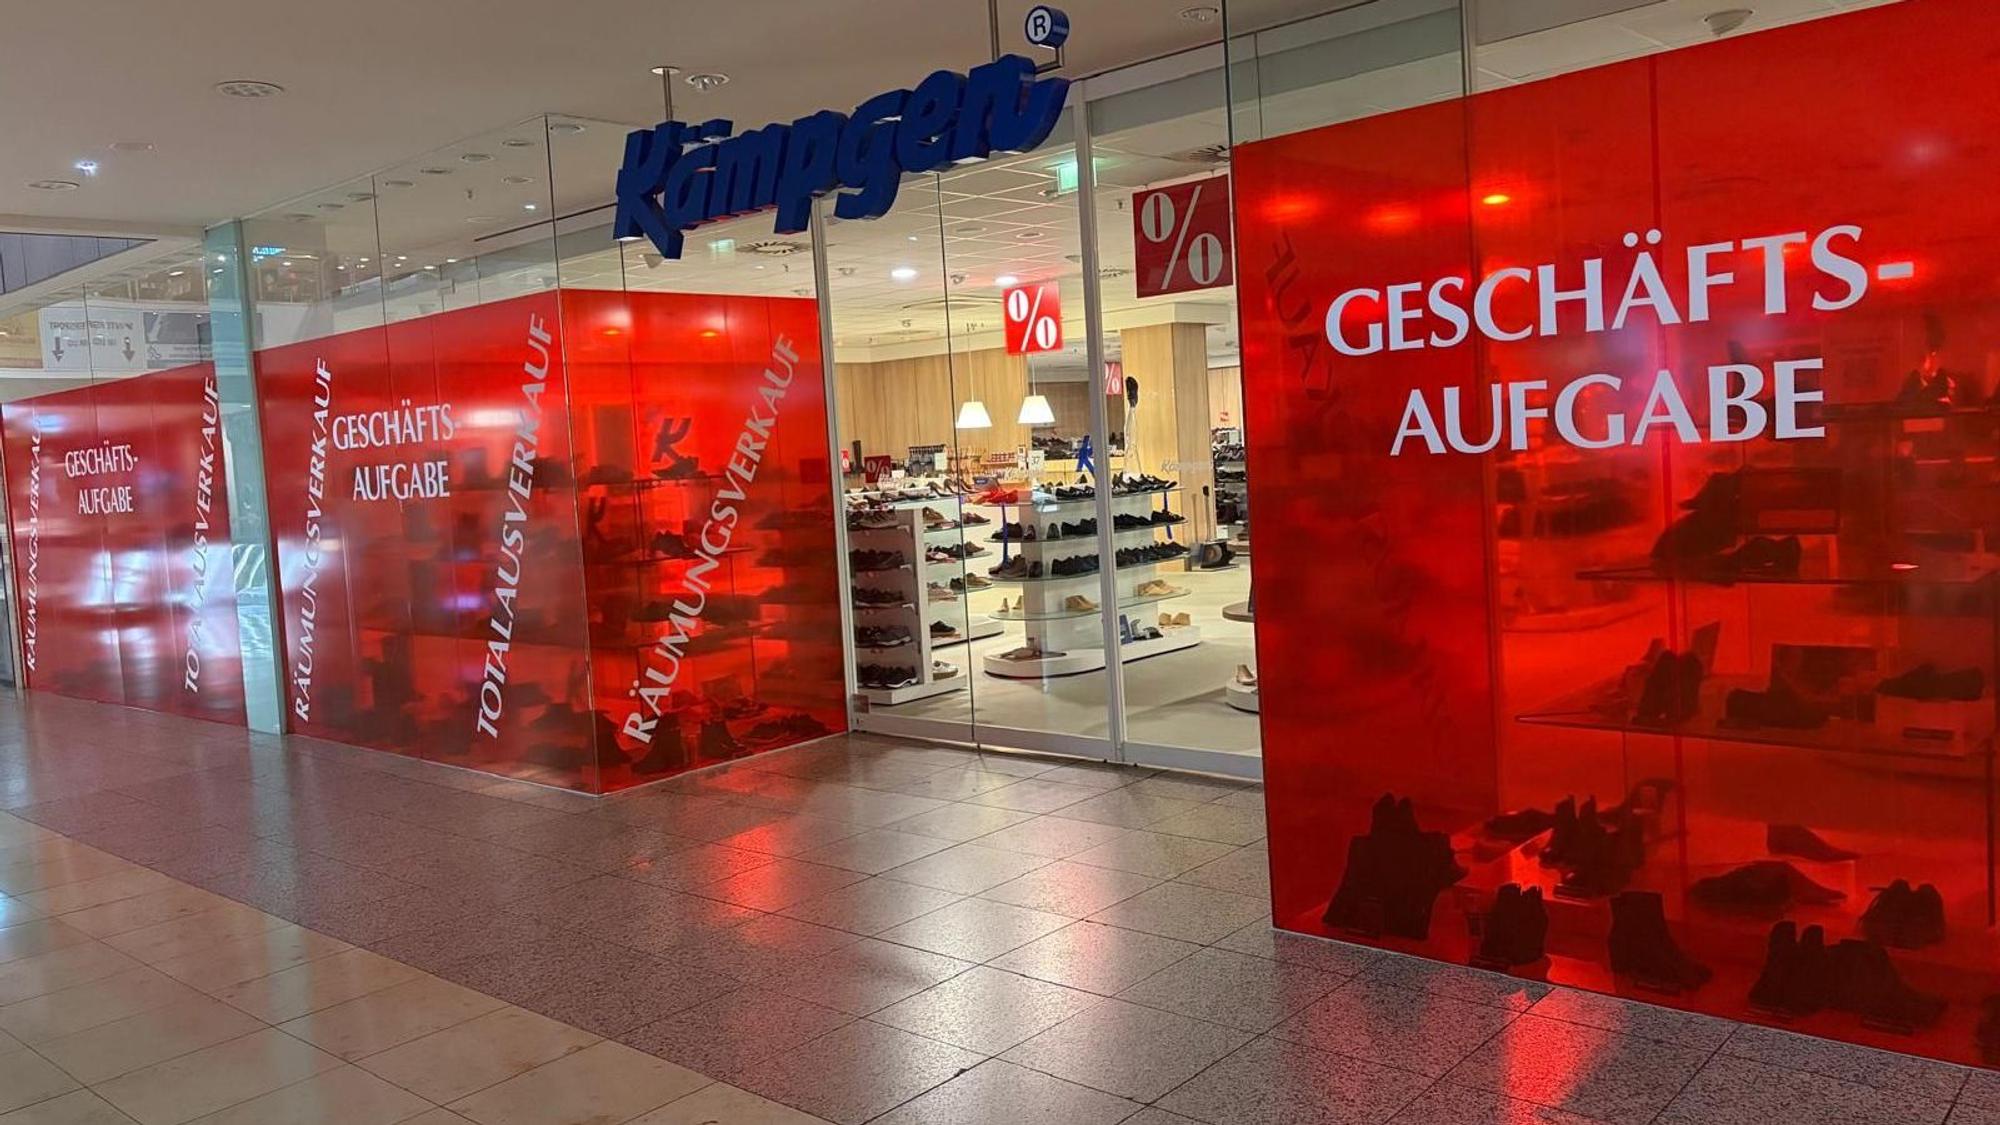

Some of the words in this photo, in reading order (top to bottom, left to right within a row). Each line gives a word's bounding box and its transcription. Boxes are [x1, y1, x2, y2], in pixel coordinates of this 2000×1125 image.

[614, 54, 1070, 260] Kämpgen
[1325, 224, 1915, 357] GESCHÄFTS-
[65, 442, 139, 477] GESCHÄFTS-
[332, 399, 461, 450] GESCHÄFTS-
[1390, 357, 1826, 457] AUFGABE
[78, 486, 134, 514] AUFGABE
[184, 376, 219, 693] TOALAUSVERKAUF
[294, 357, 332, 724] RÄUMUNGSVERKAUF
[352, 460, 450, 501] AUFGABE
[477, 312, 554, 739] TOTALAUSVERKAUF
[622, 332, 800, 744] RÄUMUNGSVERKAUF
